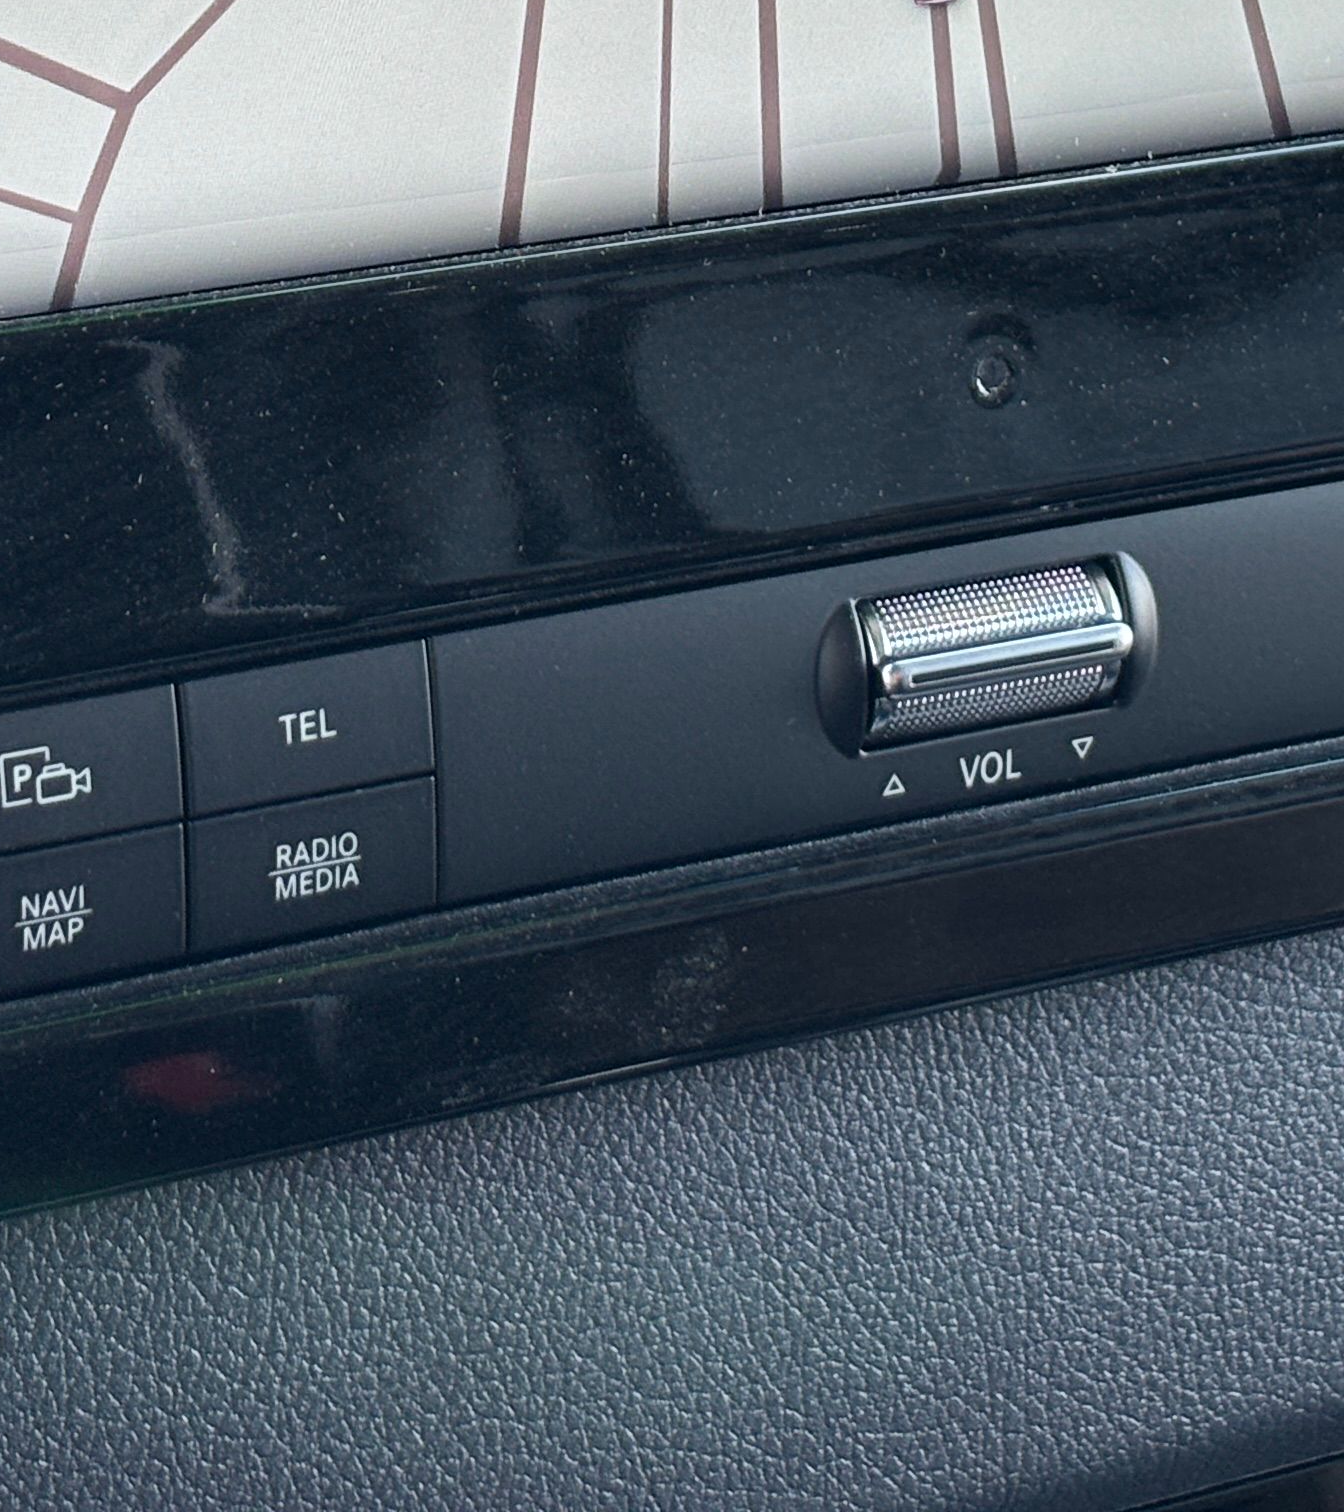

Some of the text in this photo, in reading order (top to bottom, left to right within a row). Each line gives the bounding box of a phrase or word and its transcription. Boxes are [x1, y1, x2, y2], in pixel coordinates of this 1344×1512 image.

[279, 708, 338, 745] TEL
[12, 763, 31, 793] P
[959, 748, 1023, 789] VOL
[276, 831, 359, 869] RADIO
[274, 864, 360, 902] MEDIA
[20, 884, 87, 920] NAVI
[23, 918, 85, 952] MAP
